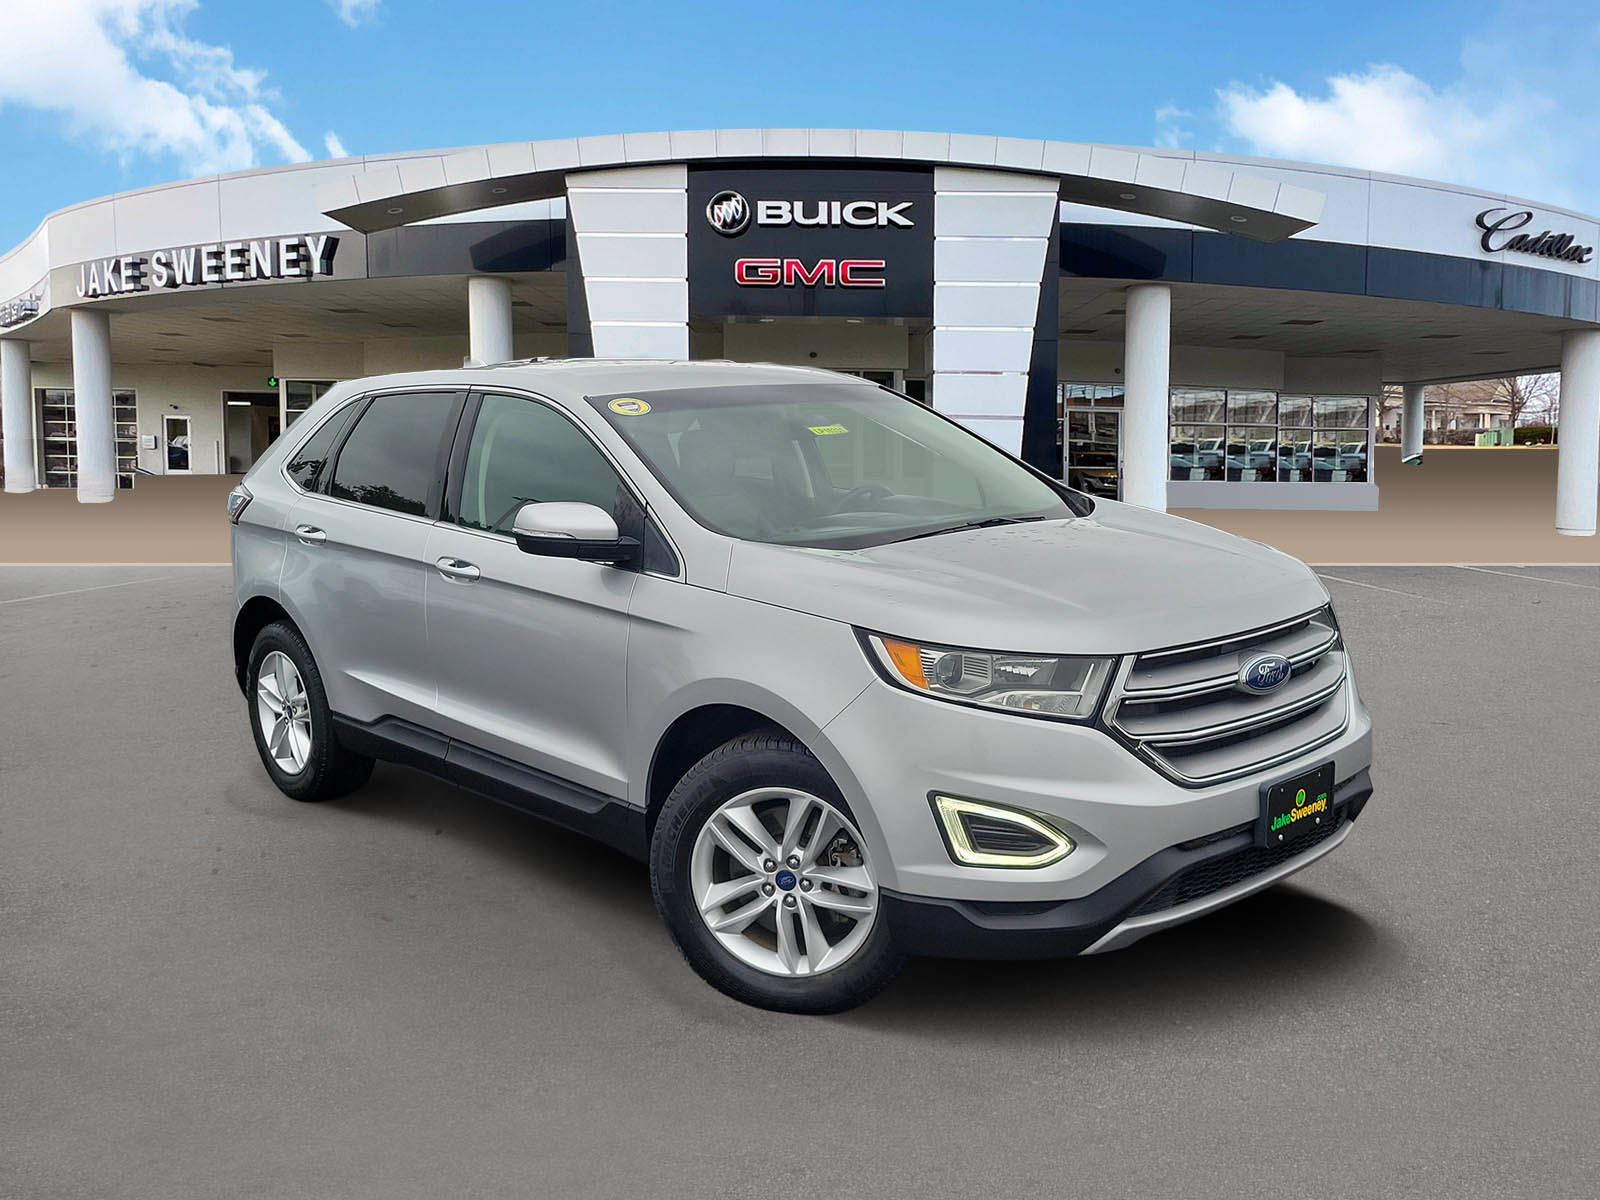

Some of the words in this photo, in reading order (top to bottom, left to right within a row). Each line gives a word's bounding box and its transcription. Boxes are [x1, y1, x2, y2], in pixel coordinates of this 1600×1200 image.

[757, 200, 915, 227] BUICK
[1475, 207, 1593, 264] Cadillac
[76, 255, 148, 298] JAKE
[151, 235, 339, 289] SWEENEY
[734, 257, 886, 288] GMC
[1257, 661, 1284, 686] Ford
